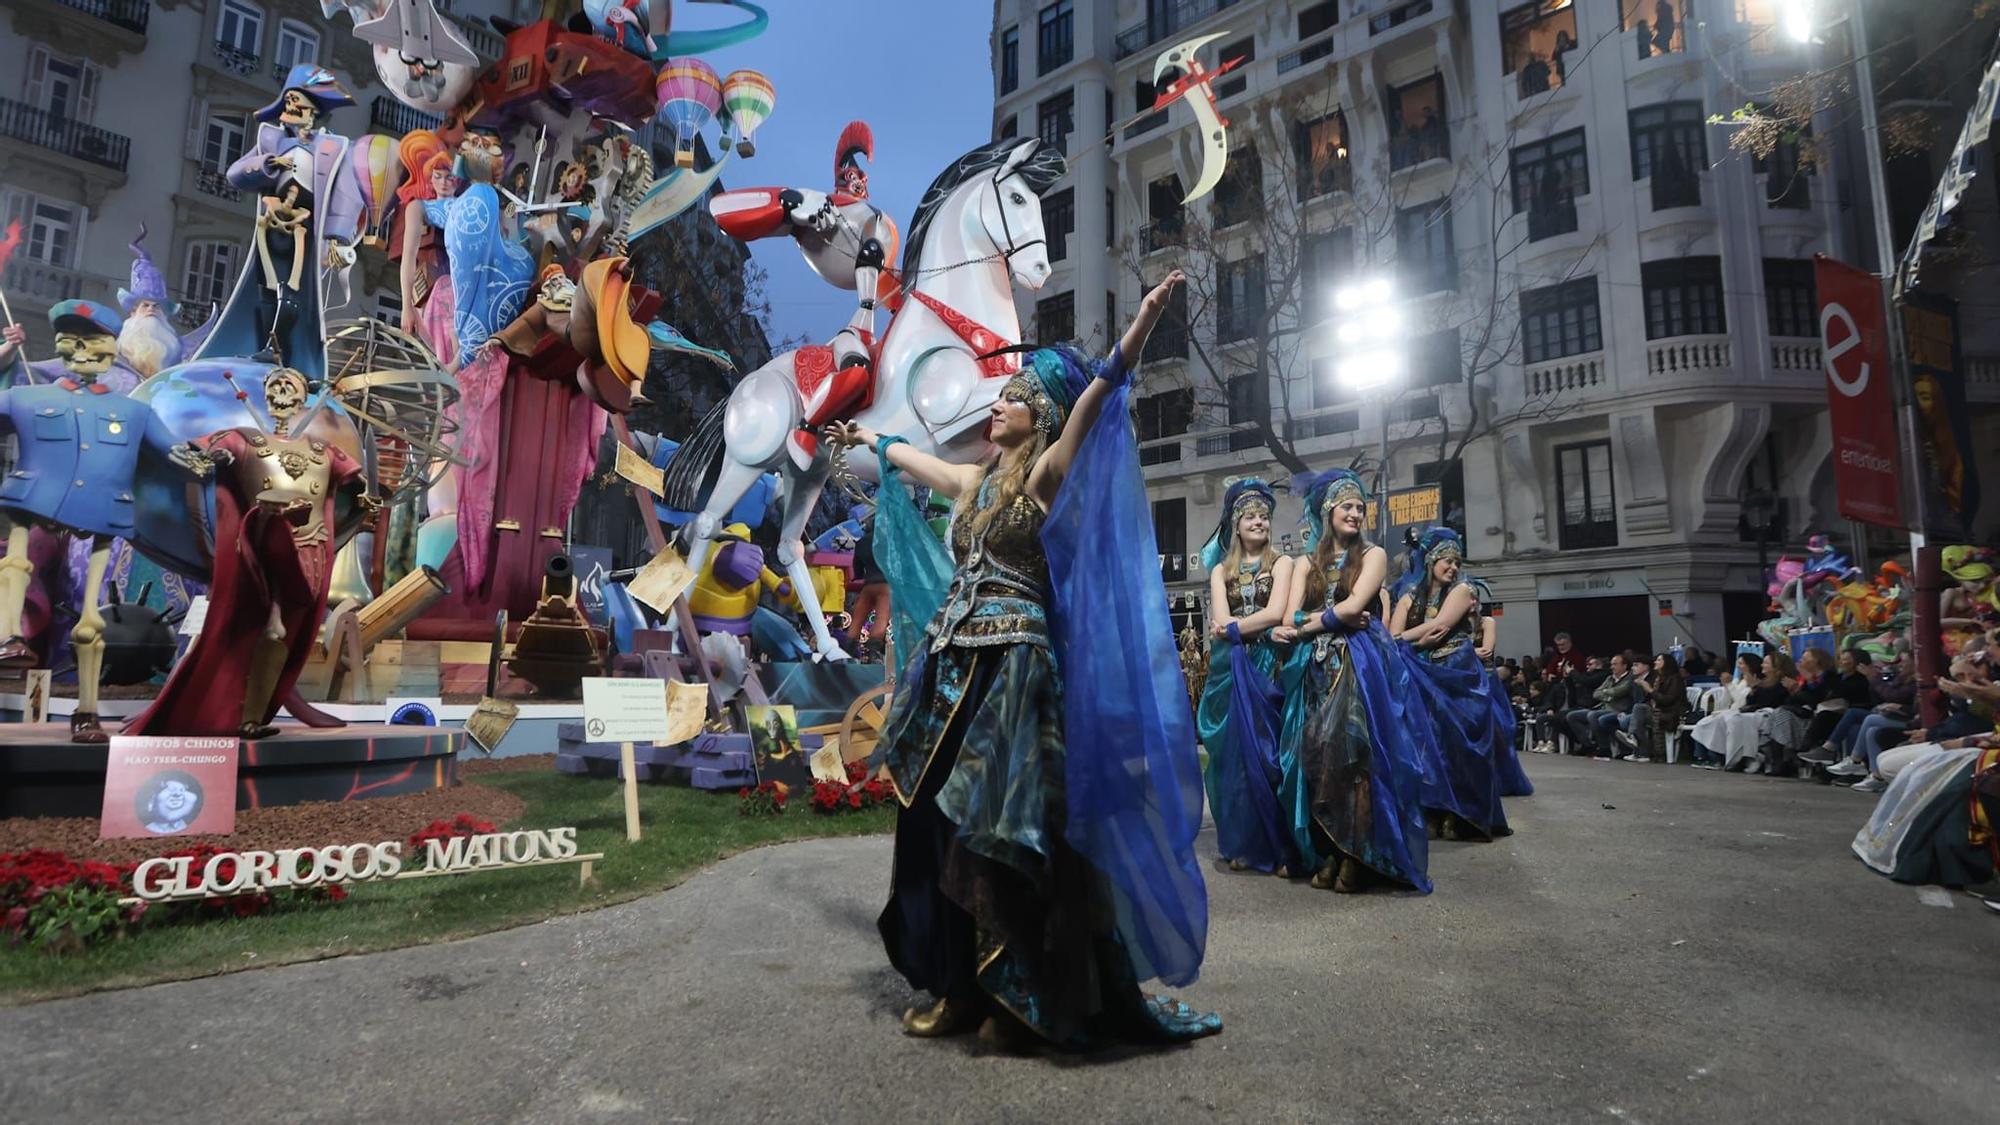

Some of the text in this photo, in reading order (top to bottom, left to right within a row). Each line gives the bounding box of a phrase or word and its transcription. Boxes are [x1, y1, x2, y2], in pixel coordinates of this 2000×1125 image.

[1820, 302, 1870, 397] e
[116, 738, 235, 749] UENTOS CHINOS
[132, 826, 577, 900] GLORIOSOS MATONS
